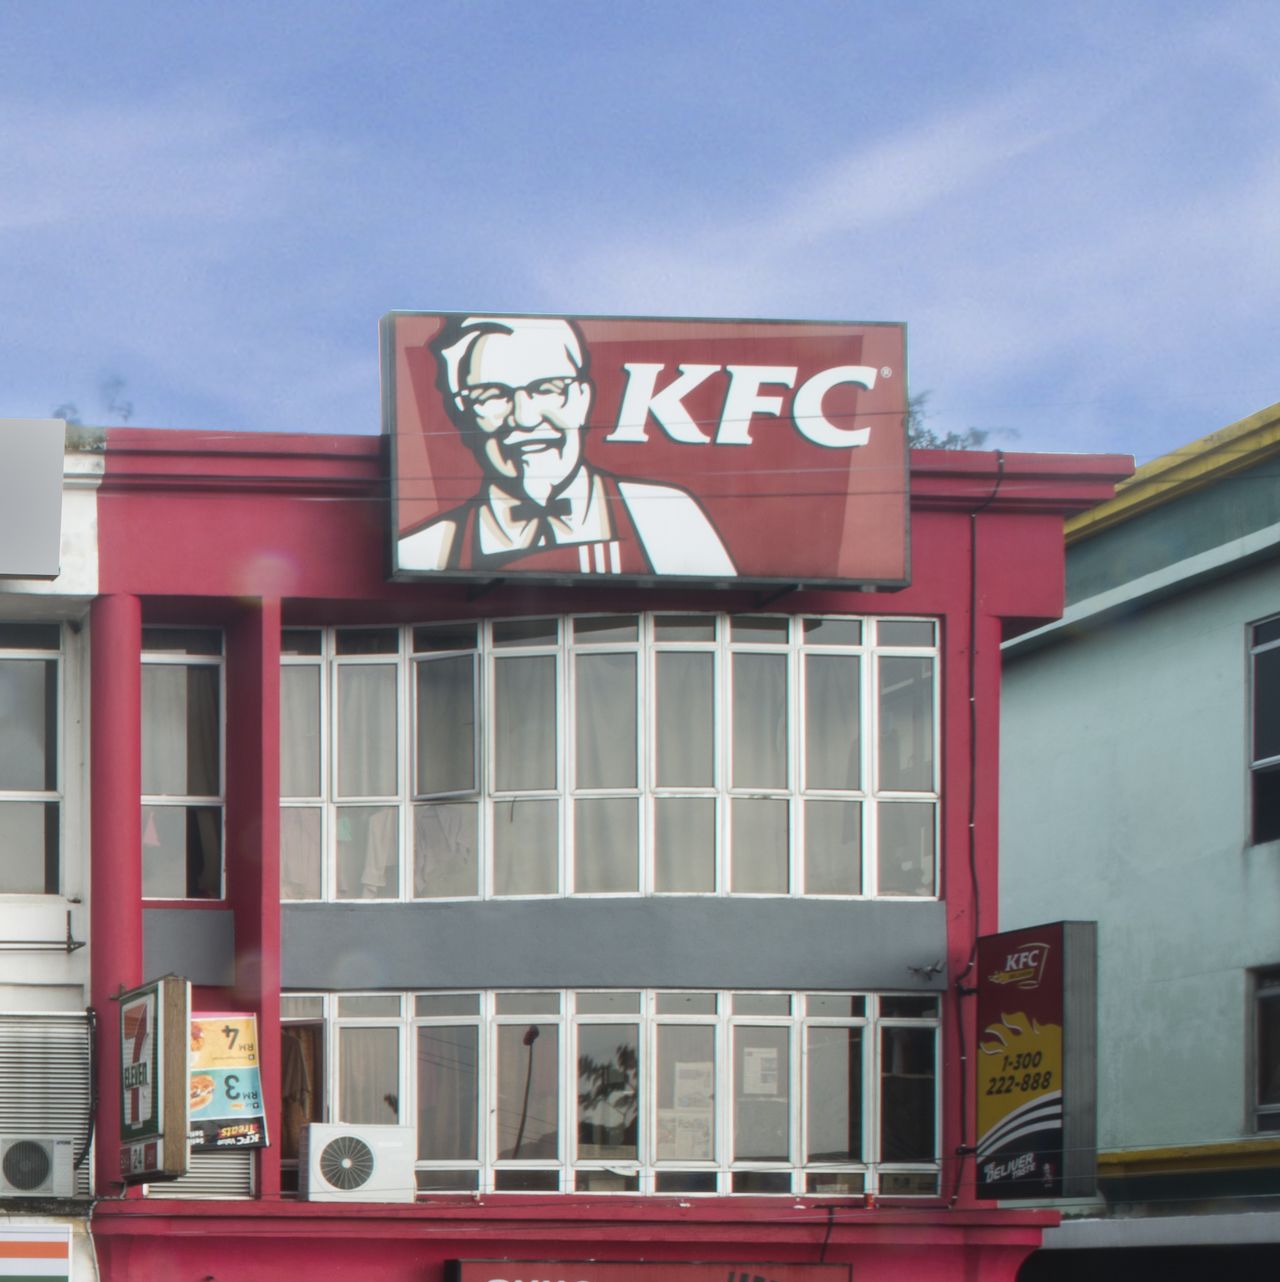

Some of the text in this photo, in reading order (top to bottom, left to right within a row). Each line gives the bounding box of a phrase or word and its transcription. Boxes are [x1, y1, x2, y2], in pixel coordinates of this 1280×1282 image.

[604, 362, 879, 448] KFC
[1005, 949, 1040, 972] KFC
[1001, 1050, 1043, 1072] 1-300
[985, 1070, 1052, 1096] 222-888
